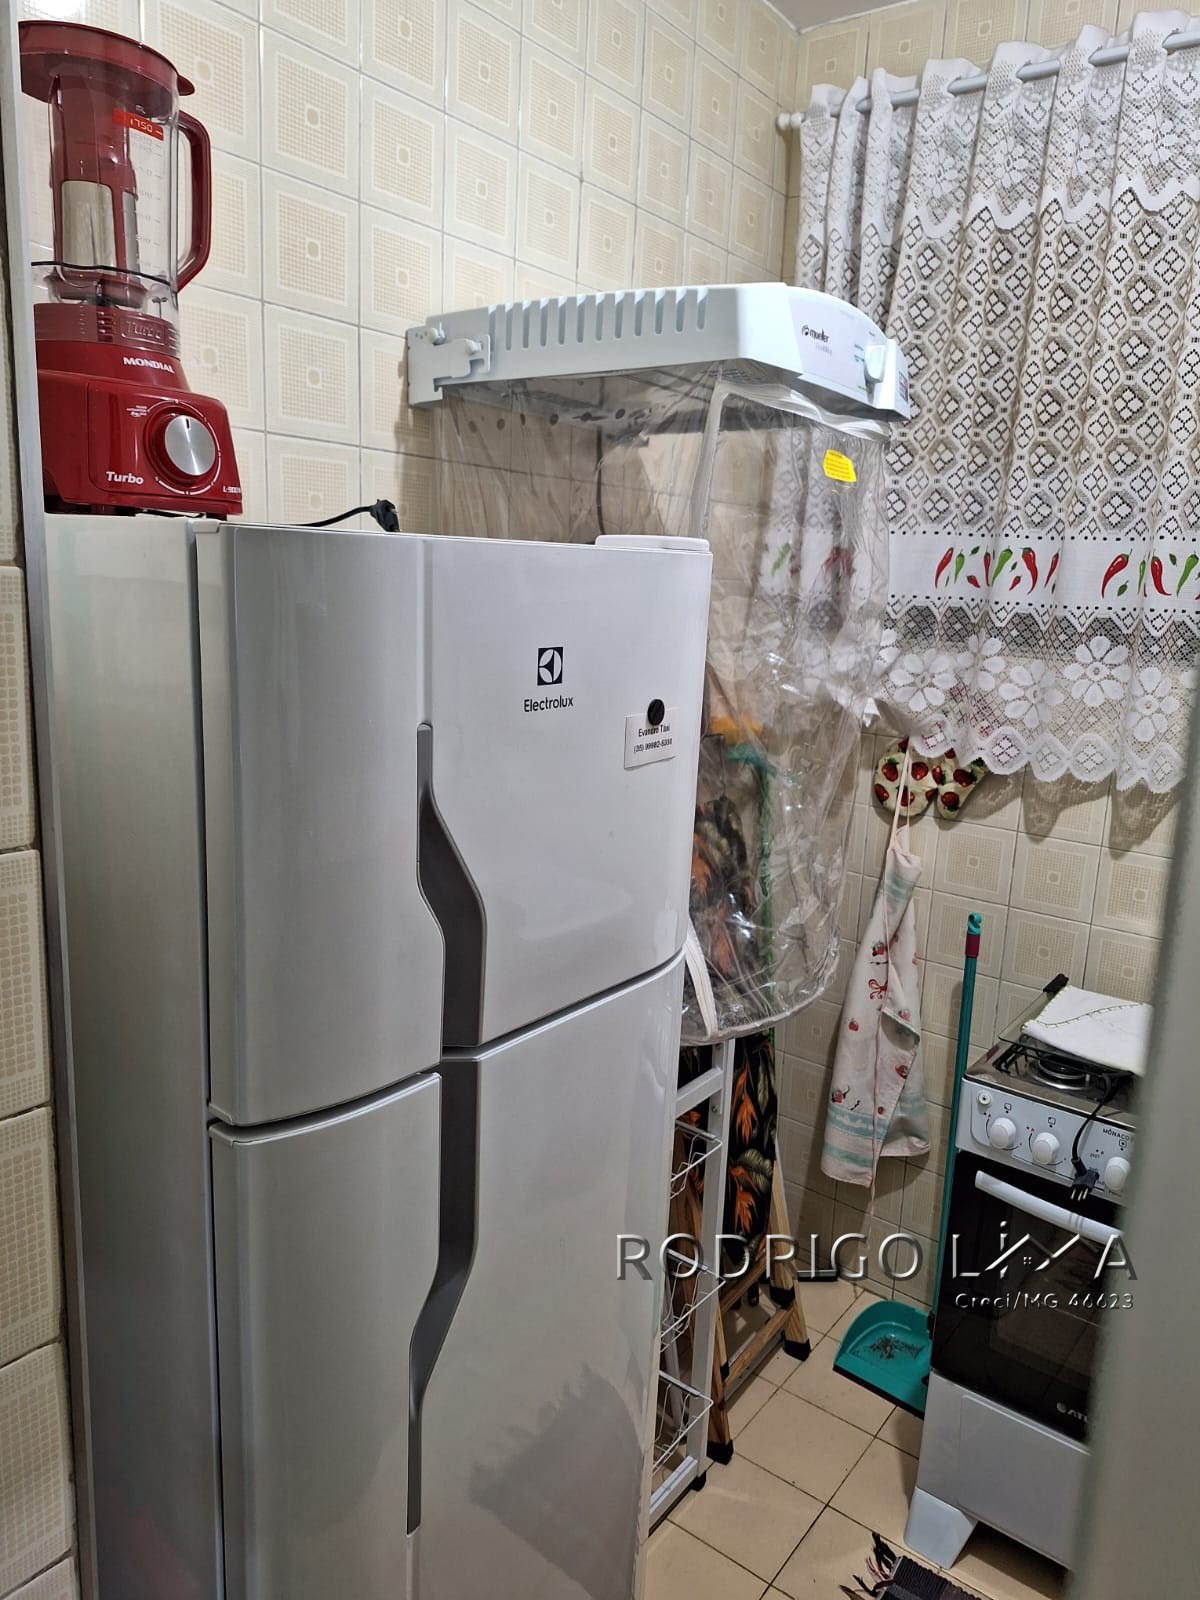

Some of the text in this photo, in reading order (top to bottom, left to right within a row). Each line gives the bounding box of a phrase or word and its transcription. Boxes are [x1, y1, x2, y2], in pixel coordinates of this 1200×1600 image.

[123, 356, 175, 373] MONDIAL
[106, 471, 144, 485] Turbo
[523, 695, 574, 713] Electrolux
